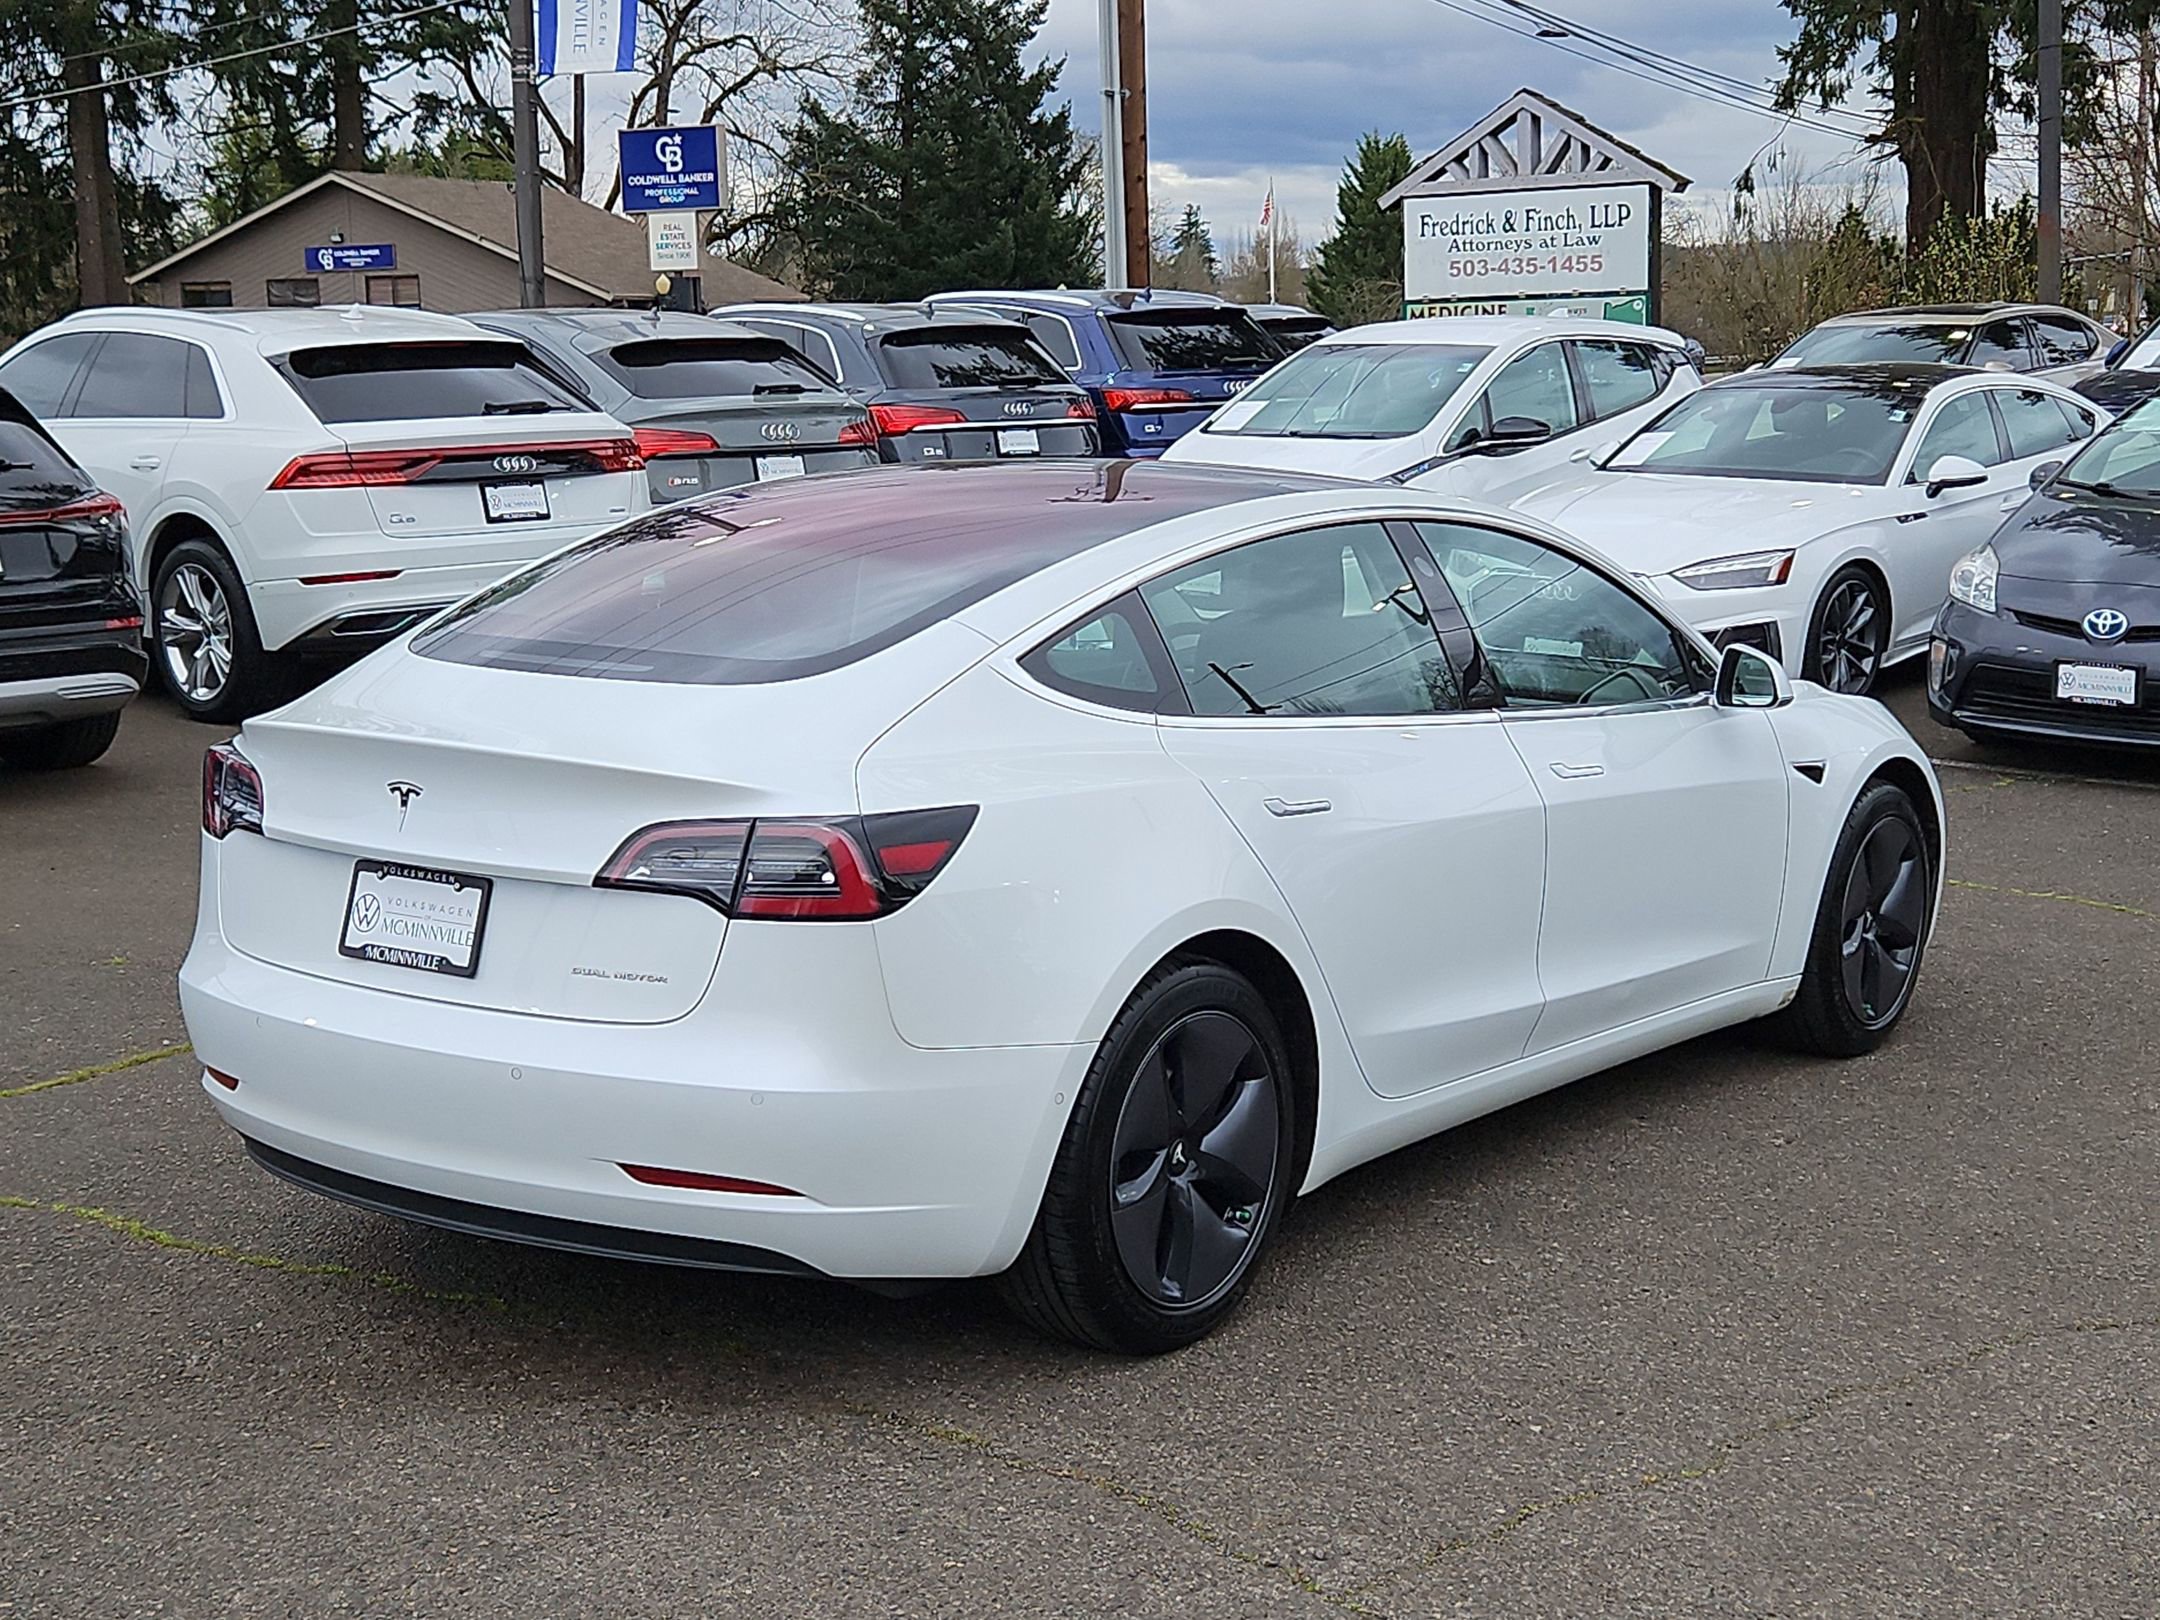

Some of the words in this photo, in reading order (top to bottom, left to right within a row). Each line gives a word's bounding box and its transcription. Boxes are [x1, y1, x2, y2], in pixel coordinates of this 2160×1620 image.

[573, 0, 588, 54] VILLE
[627, 173, 677, 186] COLDWELL
[678, 172, 714, 184] BANKER
[644, 187, 699, 197] PROFESSIONAL
[659, 195, 685, 204] GROUP
[663, 223, 682, 231] REAL
[1420, 211, 1496, 238] Fredrick
[1502, 209, 1518, 233] &
[1524, 206, 1583, 234] Finch,
[1590, 203, 1632, 229] LLP
[655, 241, 692, 250] SERVICES
[660, 232, 686, 241] ESTATE
[1448, 237, 1533, 253] Attorneys
[1539, 235, 1557, 249] at
[1563, 232, 1602, 247] Law
[1448, 254, 1603, 278] 503-435-1455
[382, 865, 456, 883] VOLKSWAGEN
[388, 897, 473, 918] VOLKSWAGEN
[381, 917, 475, 947] MCMINNVILLE
[364, 945, 441, 972] MCMINNVILLE
[571, 967, 611, 979] DUAL
[614, 971, 668, 984] MOTOR
